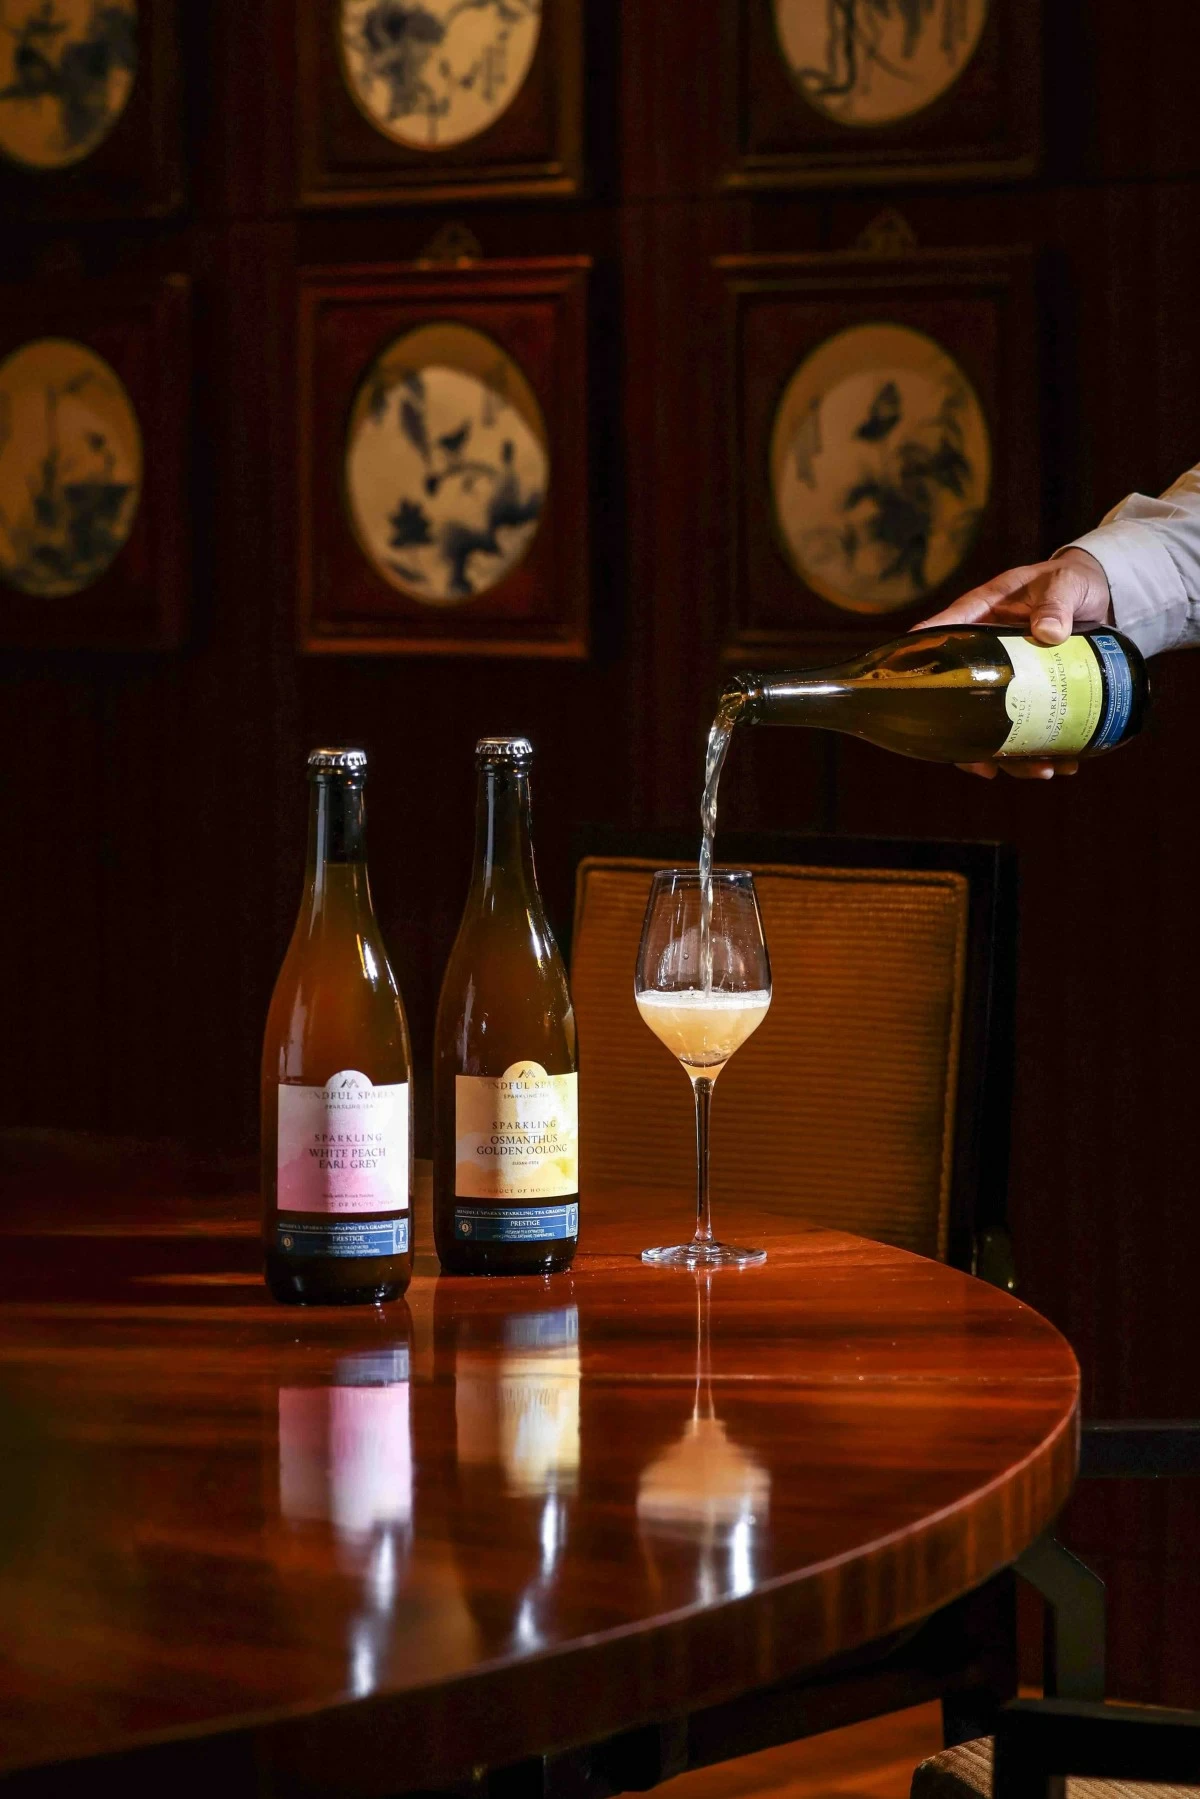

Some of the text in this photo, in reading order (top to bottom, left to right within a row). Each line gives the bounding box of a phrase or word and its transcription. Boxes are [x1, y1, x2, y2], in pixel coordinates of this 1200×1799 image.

[1046, 667, 1057, 730] SPARKLING
[1049, 652, 1069, 743] YUZU GENMAICHA
[1008, 698, 1026, 744] MINDFUL
[483, 1081, 530, 1090] NDFUL
[492, 1120, 557, 1129] SPARKLING
[314, 1133, 383, 1142] SPARKLING
[490, 1134, 558, 1145] OSMANTHUS
[309, 1147, 386, 1158] WHITE PEACH
[476, 1143, 568, 1156] GOLDEN OOLONG
[319, 1159, 378, 1169] EARL GREY
[510, 1219, 541, 1227] PRESTIGE
[332, 1234, 365, 1242] PRESTIGE
